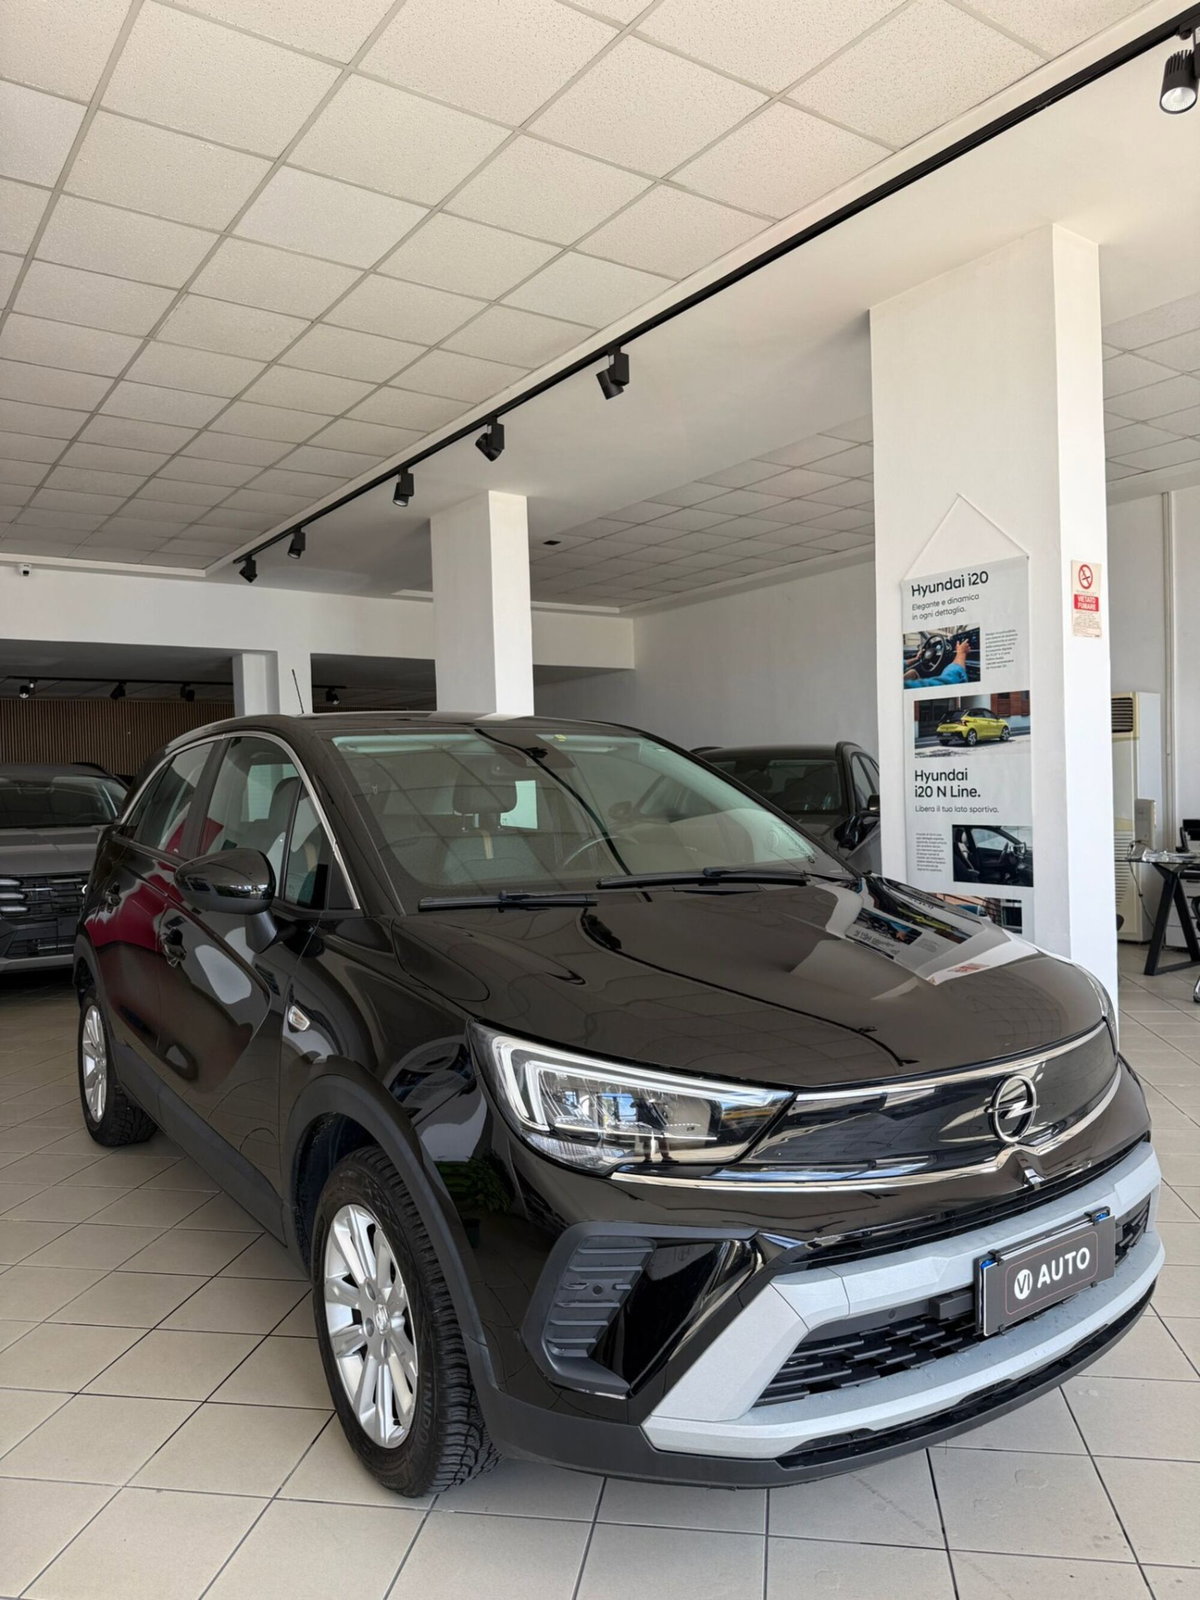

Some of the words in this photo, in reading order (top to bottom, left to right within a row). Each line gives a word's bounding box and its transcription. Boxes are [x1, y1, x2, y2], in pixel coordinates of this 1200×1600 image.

[911, 574, 965, 598] Hyundai
[968, 571, 989, 586] i20
[912, 601, 940, 611] Elegante
[947, 594, 980, 605] dinamica
[912, 612, 918, 620] in
[919, 610, 934, 620] ogni
[935, 606, 966, 617] dettaglio.
[914, 767, 968, 784] Hyundai
[914, 785, 934, 798] i20
[937, 785, 947, 798] N
[950, 785, 981, 798] Line.
[915, 805, 936, 813] Libera
[936, 805, 941, 813] il
[941, 805, 954, 813] tuo
[954, 805, 968, 813] lato
[969, 804, 1000, 814] sportiva.
[1037, 1247, 1090, 1288] AUTO
